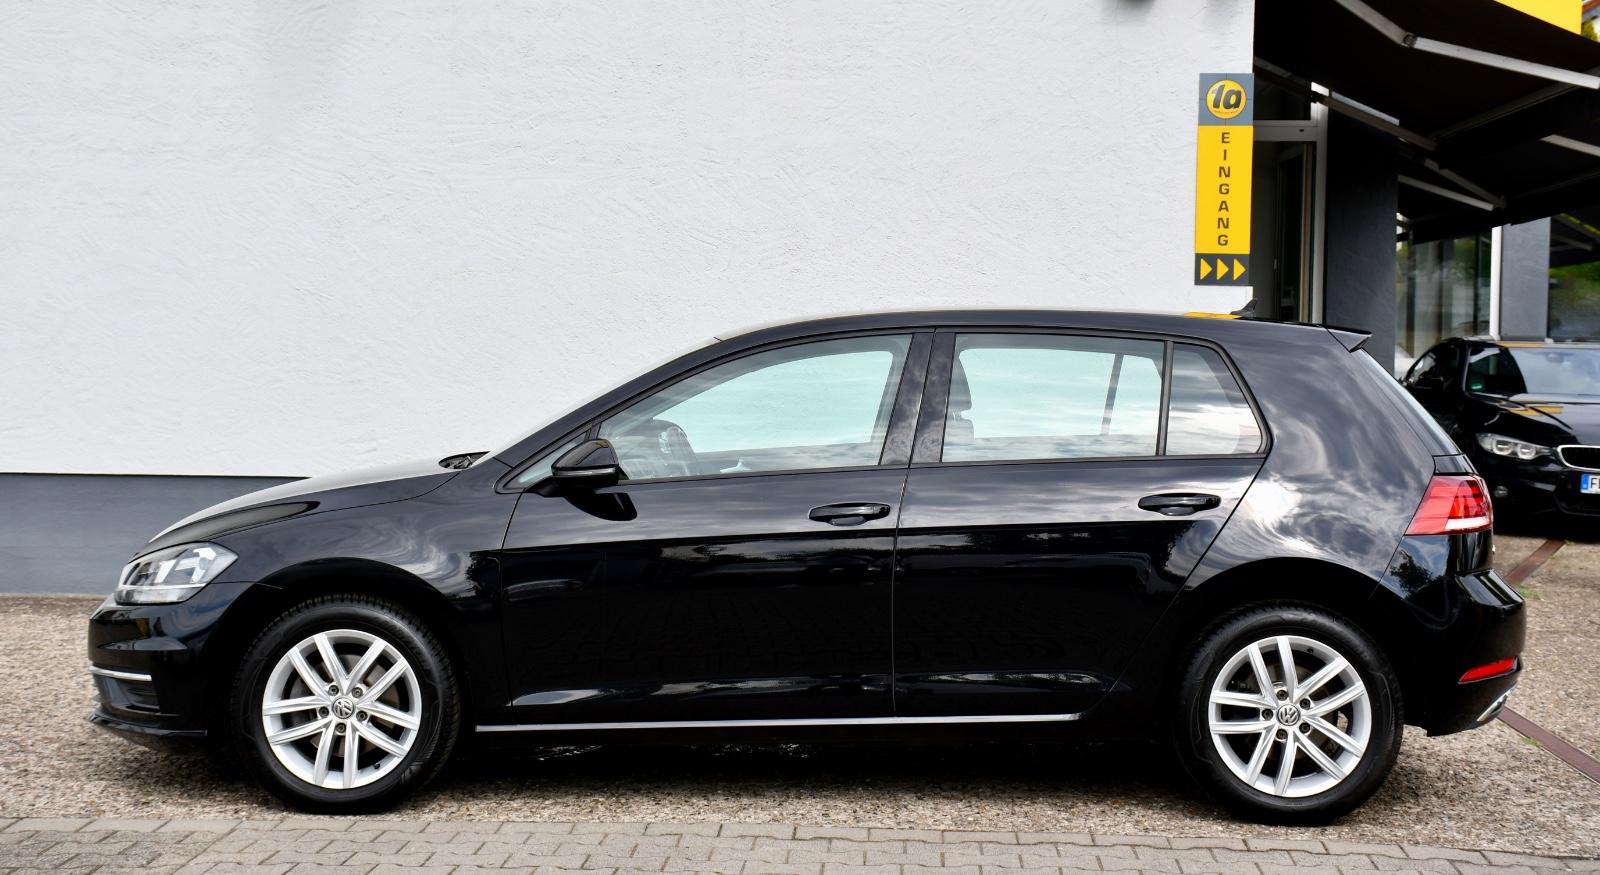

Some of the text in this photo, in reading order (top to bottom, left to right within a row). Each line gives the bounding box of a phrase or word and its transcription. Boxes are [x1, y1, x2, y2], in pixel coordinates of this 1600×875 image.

[1211, 84, 1242, 110] 1a
[1217, 131, 1231, 247] EINGANG
[1590, 477, 1600, 489] F
